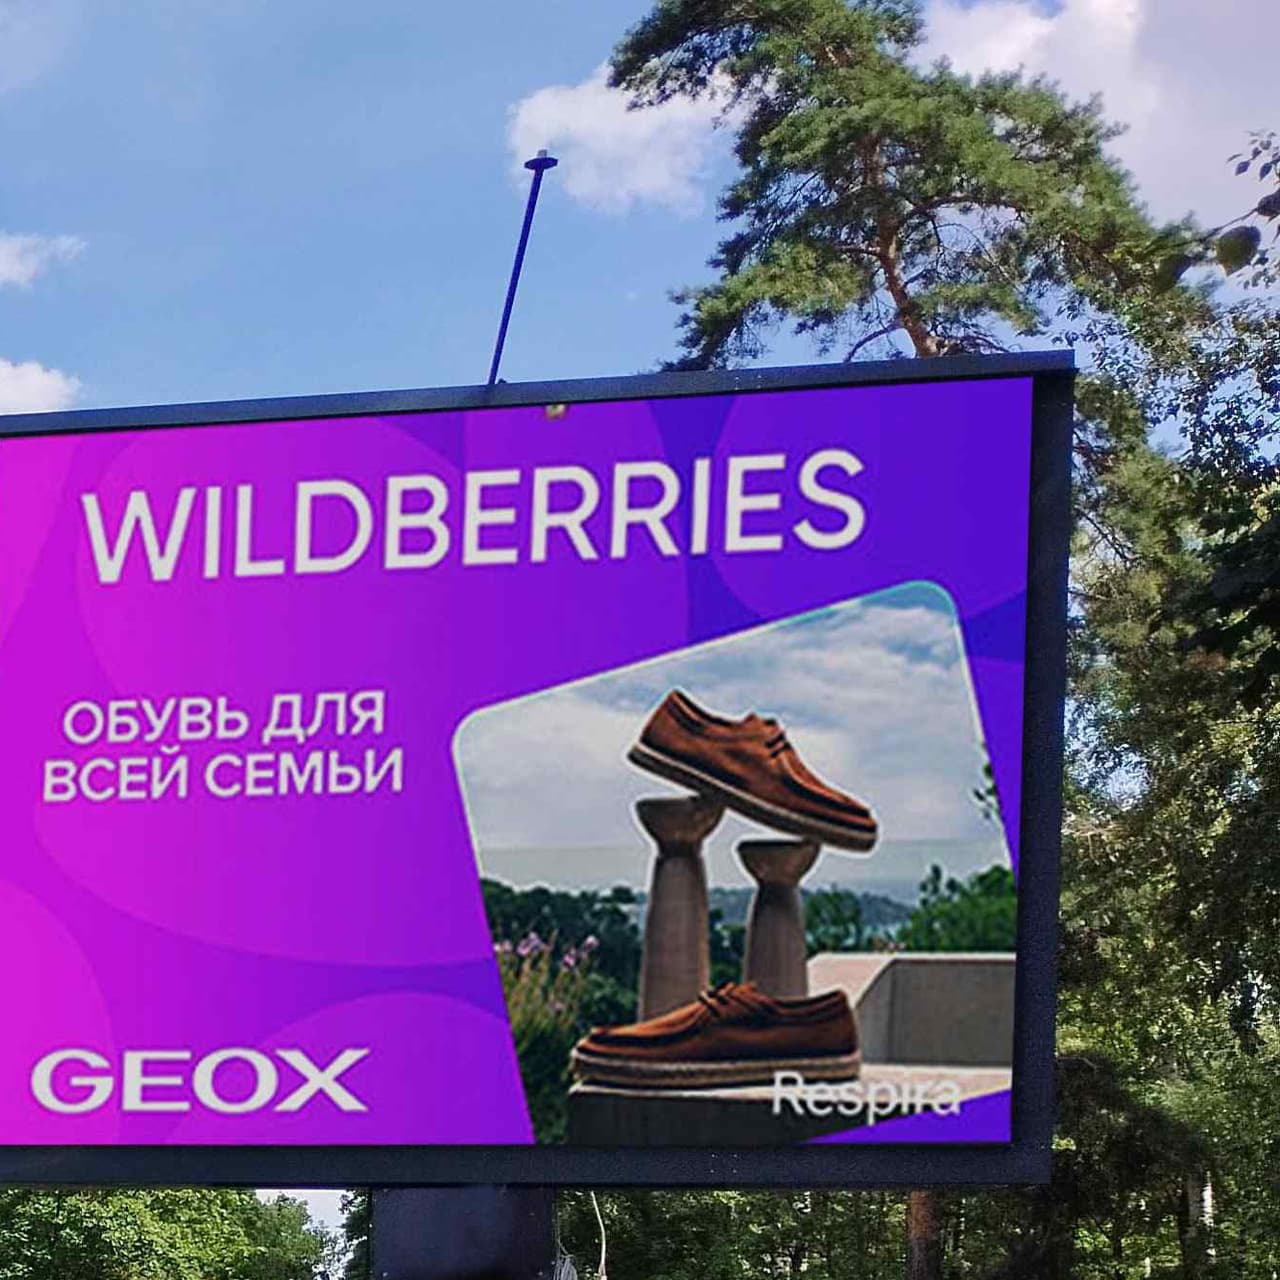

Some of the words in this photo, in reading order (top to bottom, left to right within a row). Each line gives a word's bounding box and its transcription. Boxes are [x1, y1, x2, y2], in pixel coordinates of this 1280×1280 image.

[80, 448, 866, 585] WILDBERRIES
[62, 697, 250, 744] ОБУВЬ
[262, 690, 386, 746] ДЛЯ
[42, 745, 189, 802] ВСЕЙ
[204, 747, 404, 797] СЕМЬИ
[30, 1047, 371, 1114] GEOX
[772, 1070, 961, 1127] Respira
